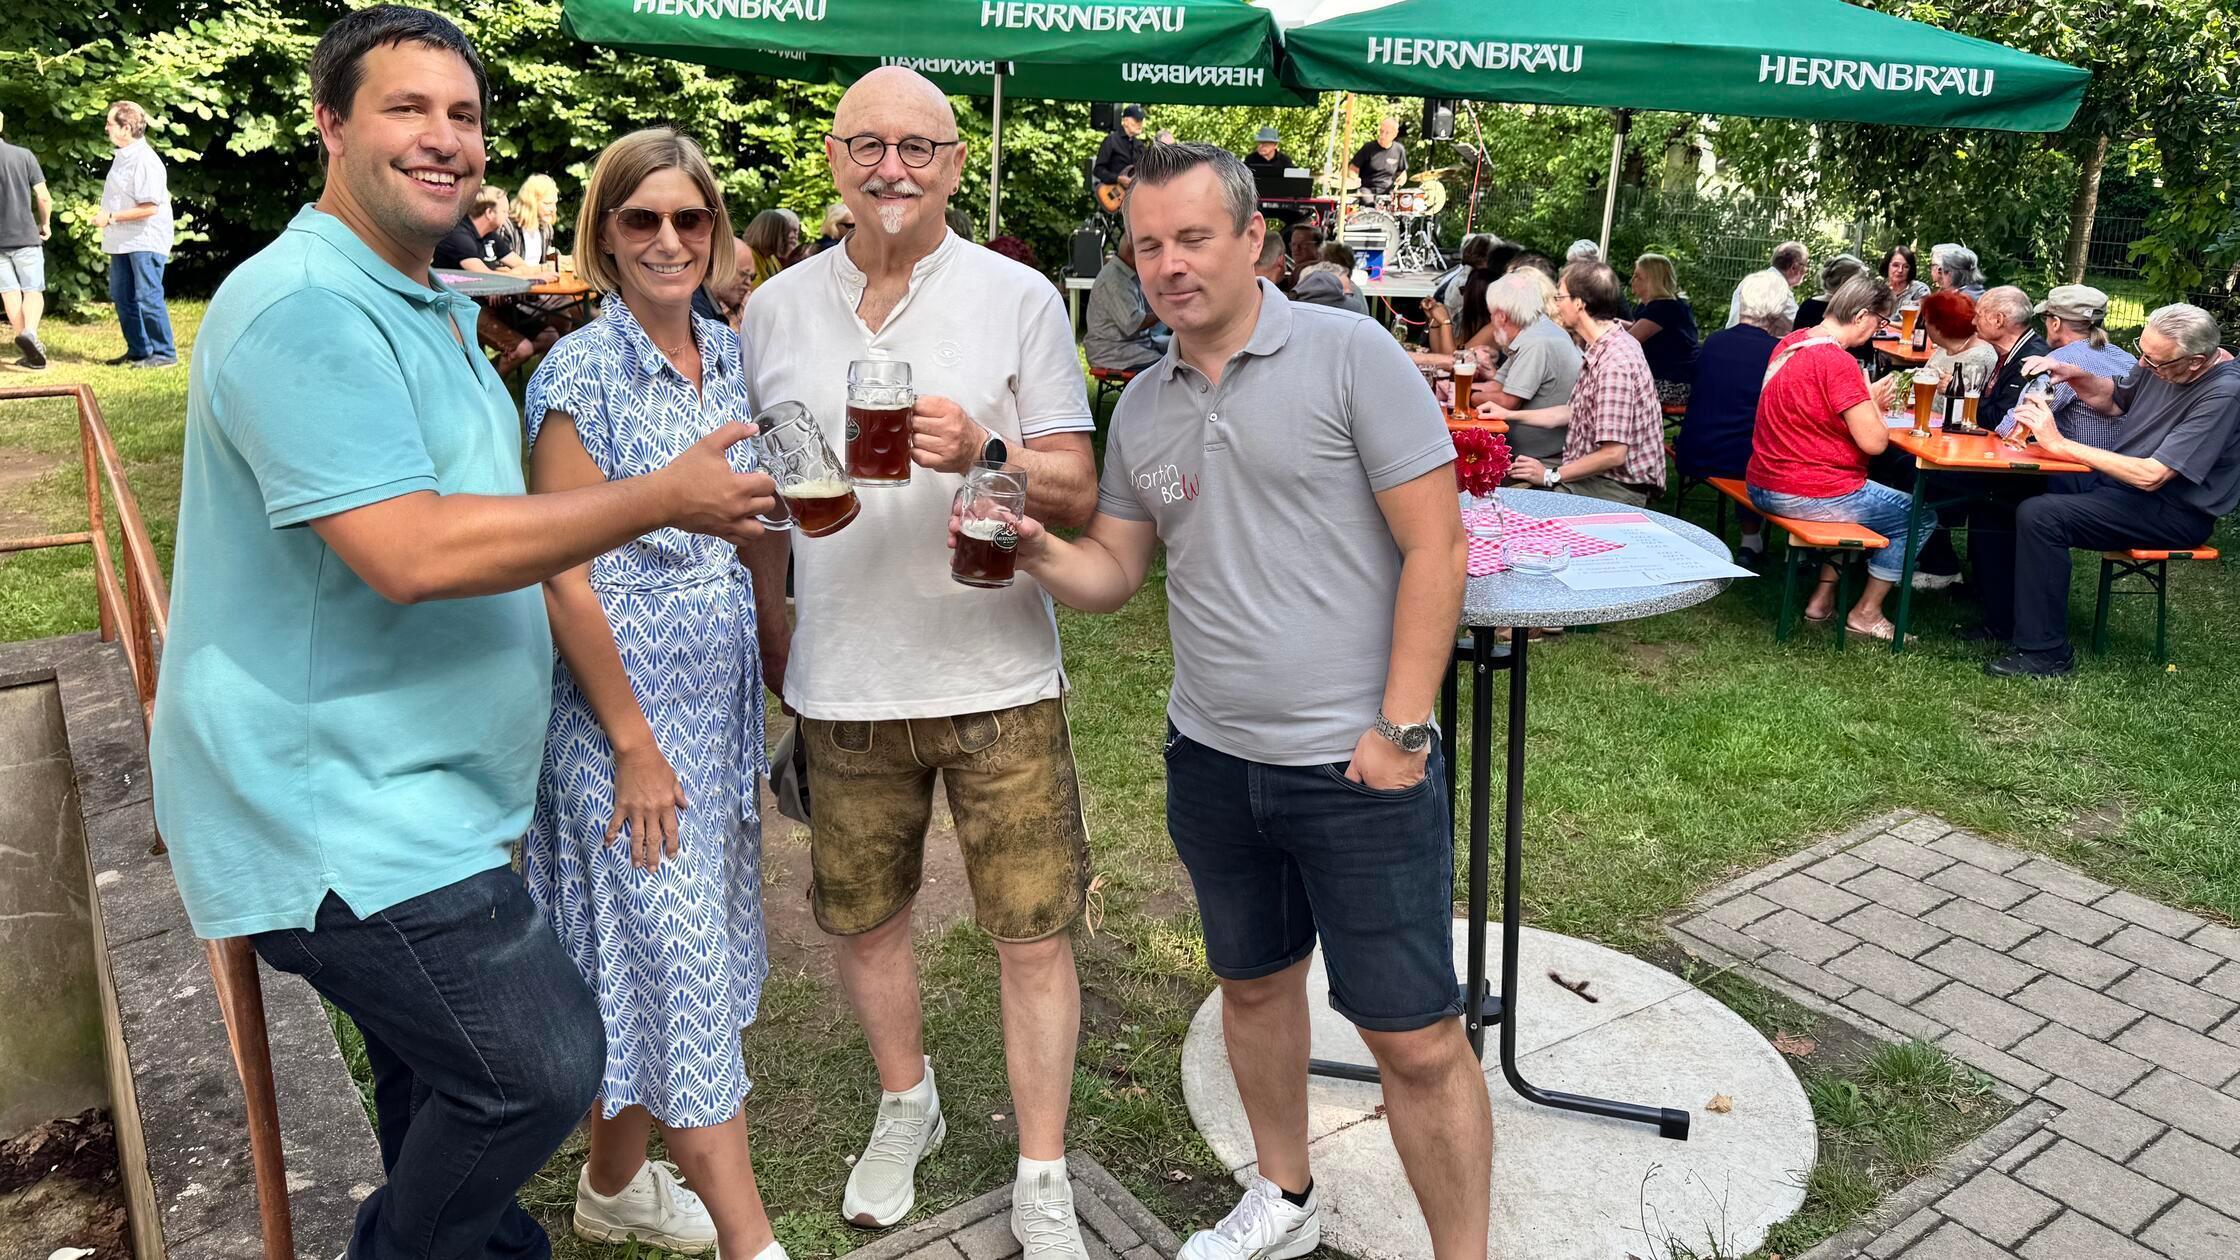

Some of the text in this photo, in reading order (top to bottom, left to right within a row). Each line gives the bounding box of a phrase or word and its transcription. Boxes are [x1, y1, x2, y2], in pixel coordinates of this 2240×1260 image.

[980, 0, 1186, 34] HERRNBRÄU
[1367, 36, 1584, 74] HERRNBRÄU
[1758, 54, 1995, 97] HERRNBRÄU
